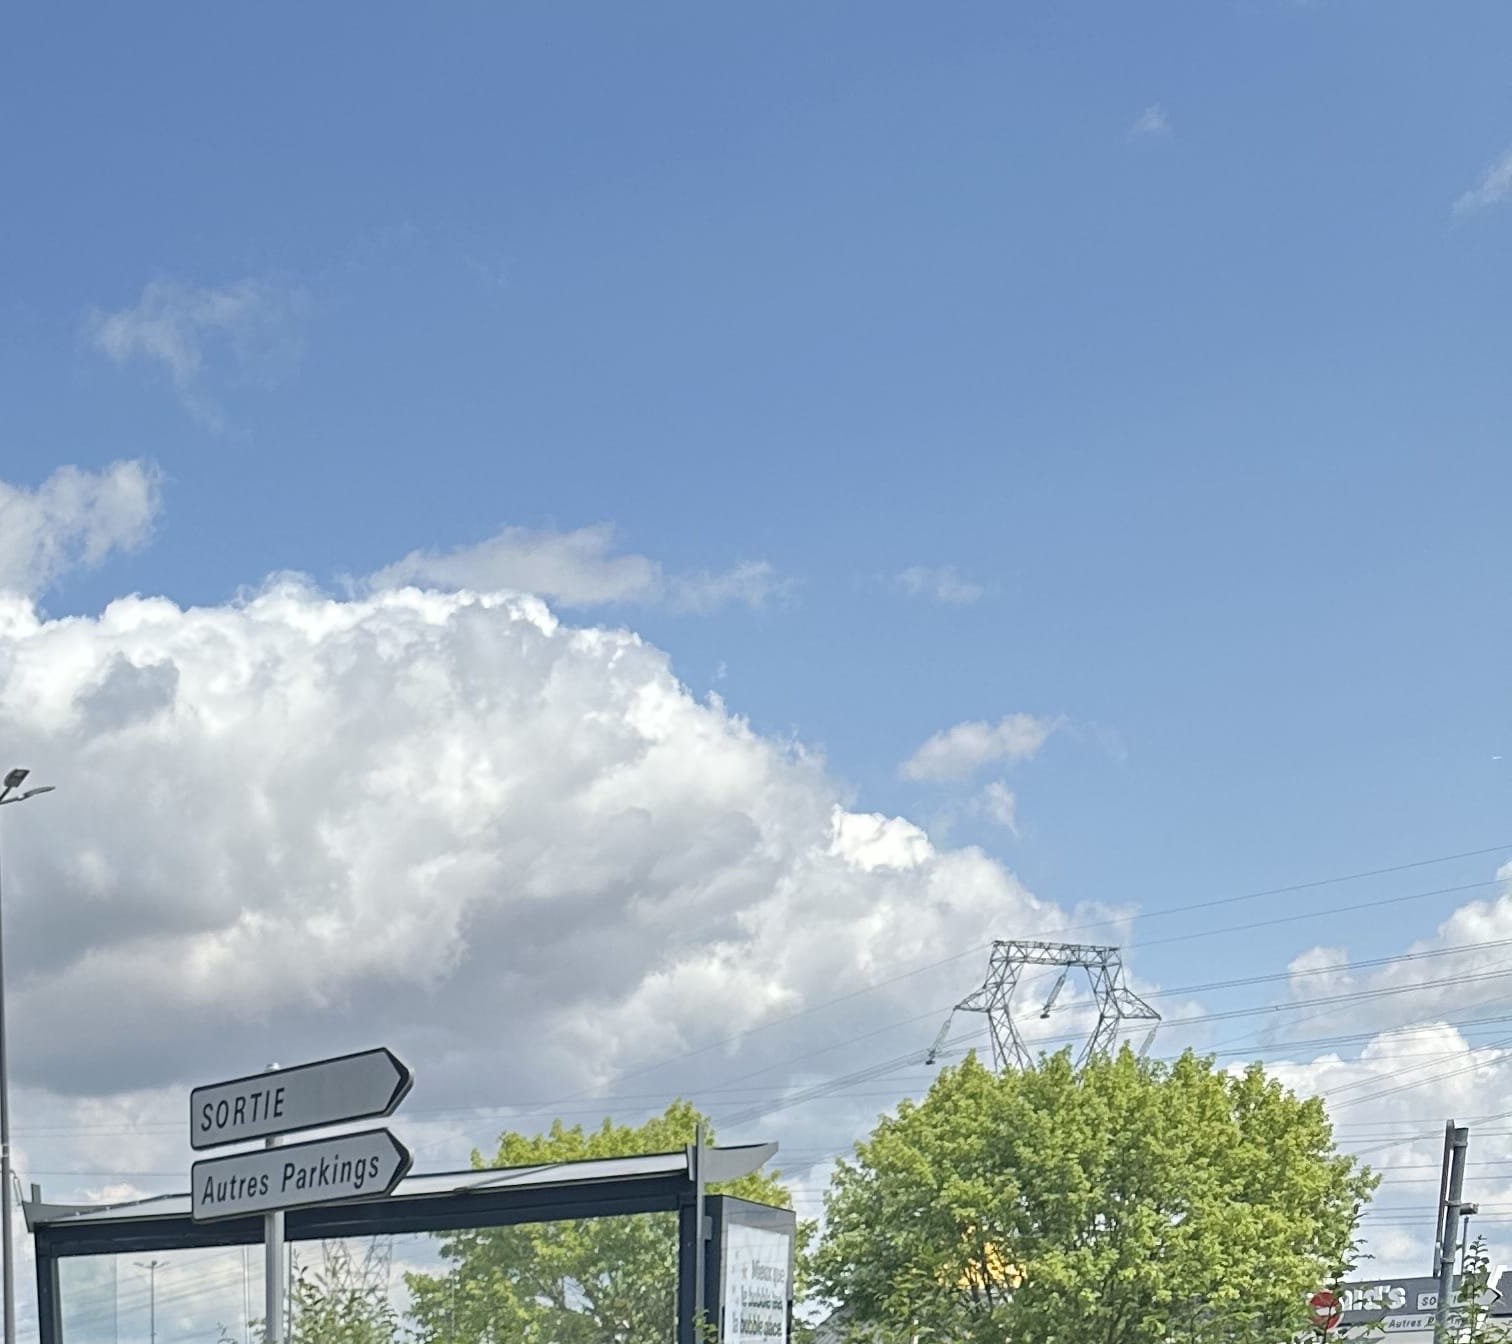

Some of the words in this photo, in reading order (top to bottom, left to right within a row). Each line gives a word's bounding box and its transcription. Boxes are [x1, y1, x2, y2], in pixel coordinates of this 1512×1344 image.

[200, 1086, 286, 1132] SORTIE
[201, 1173, 269, 1205] Autres
[281, 1153, 380, 1193] Parkings
[1388, 1318, 1422, 1329] Autres
